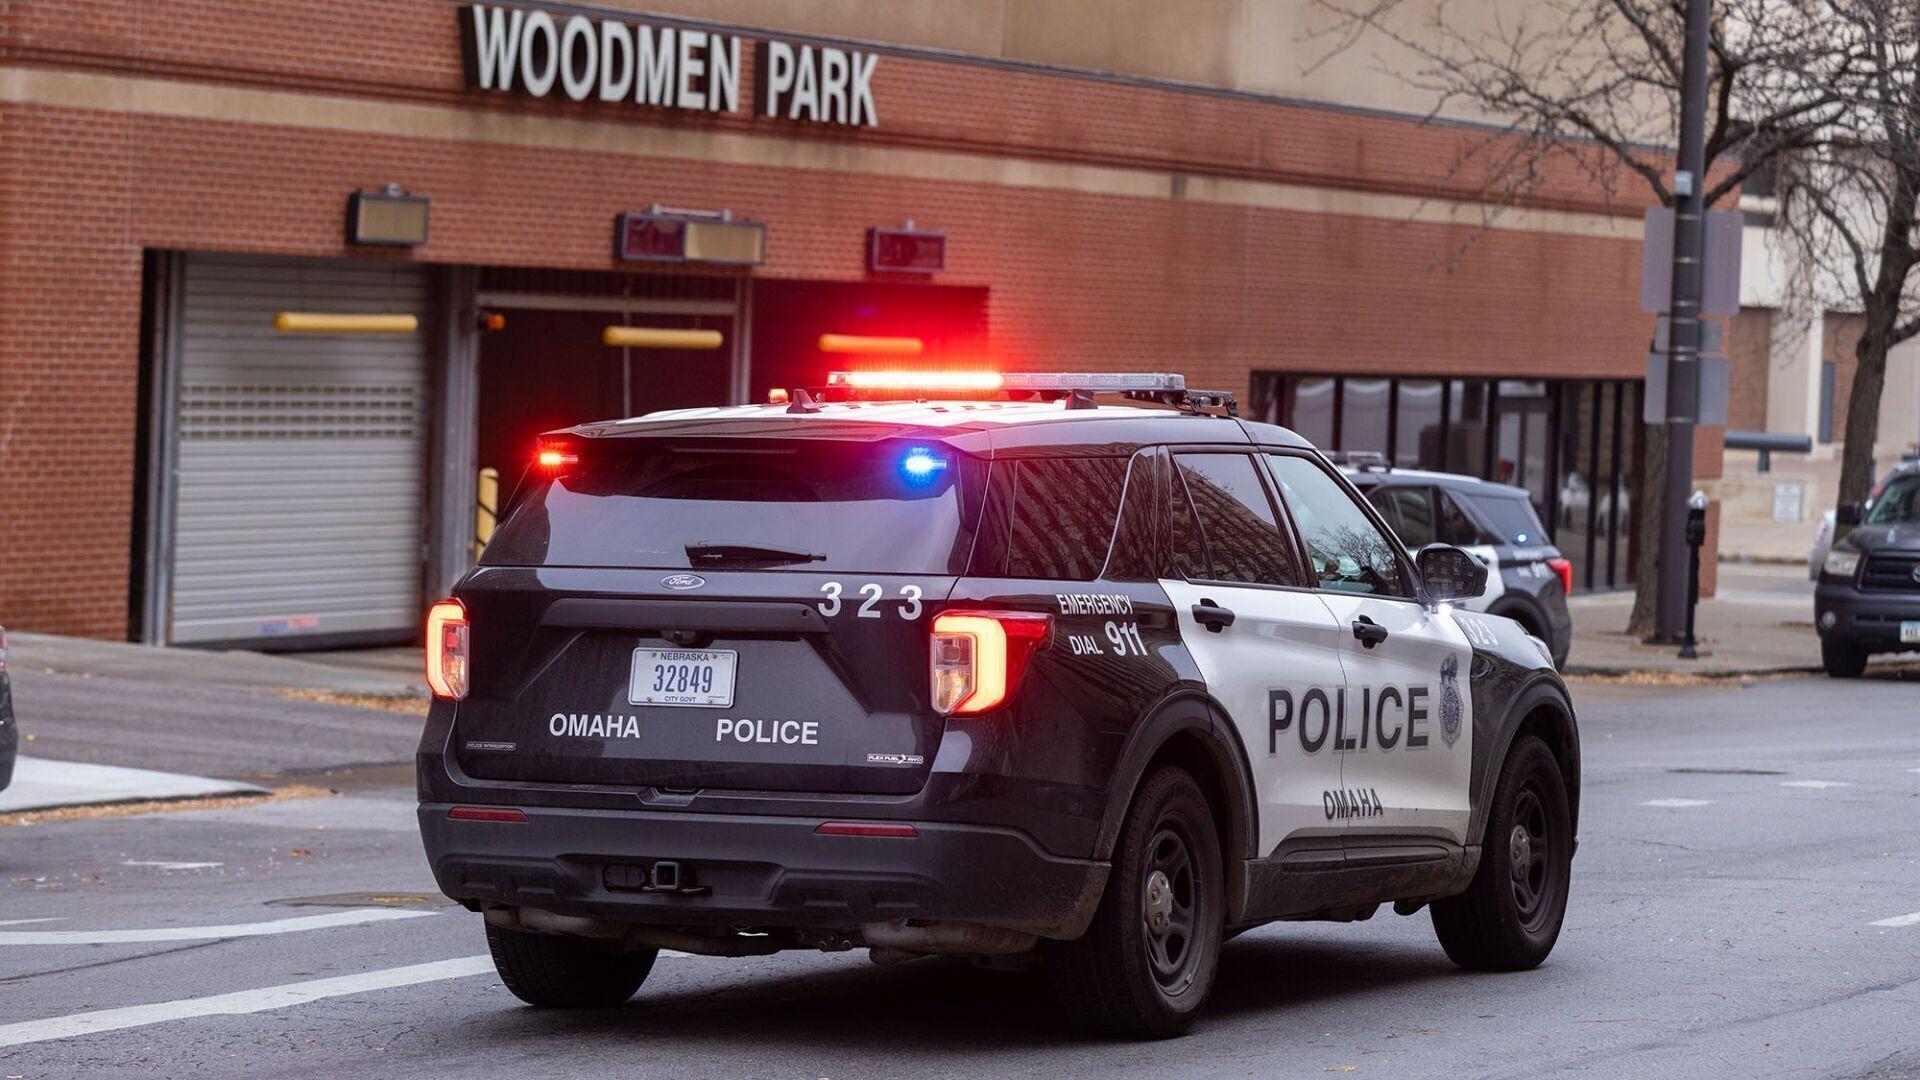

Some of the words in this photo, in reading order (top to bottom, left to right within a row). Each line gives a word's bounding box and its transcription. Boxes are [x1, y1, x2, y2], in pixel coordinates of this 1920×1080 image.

[473, 4, 741, 114] WOODMEN
[767, 41, 879, 127] PARK
[1056, 594, 1133, 614] EMERGENCY
[1068, 635, 1104, 655] DIAL
[1104, 620, 1148, 656] 911
[660, 652, 709, 662] NEBRASKA
[653, 664, 713, 693] 32849
[549, 712, 641, 739] OMAHA
[715, 718, 819, 745] POLICE
[1267, 685, 1429, 755] POLICE
[1322, 788, 1384, 820] OMAHA
